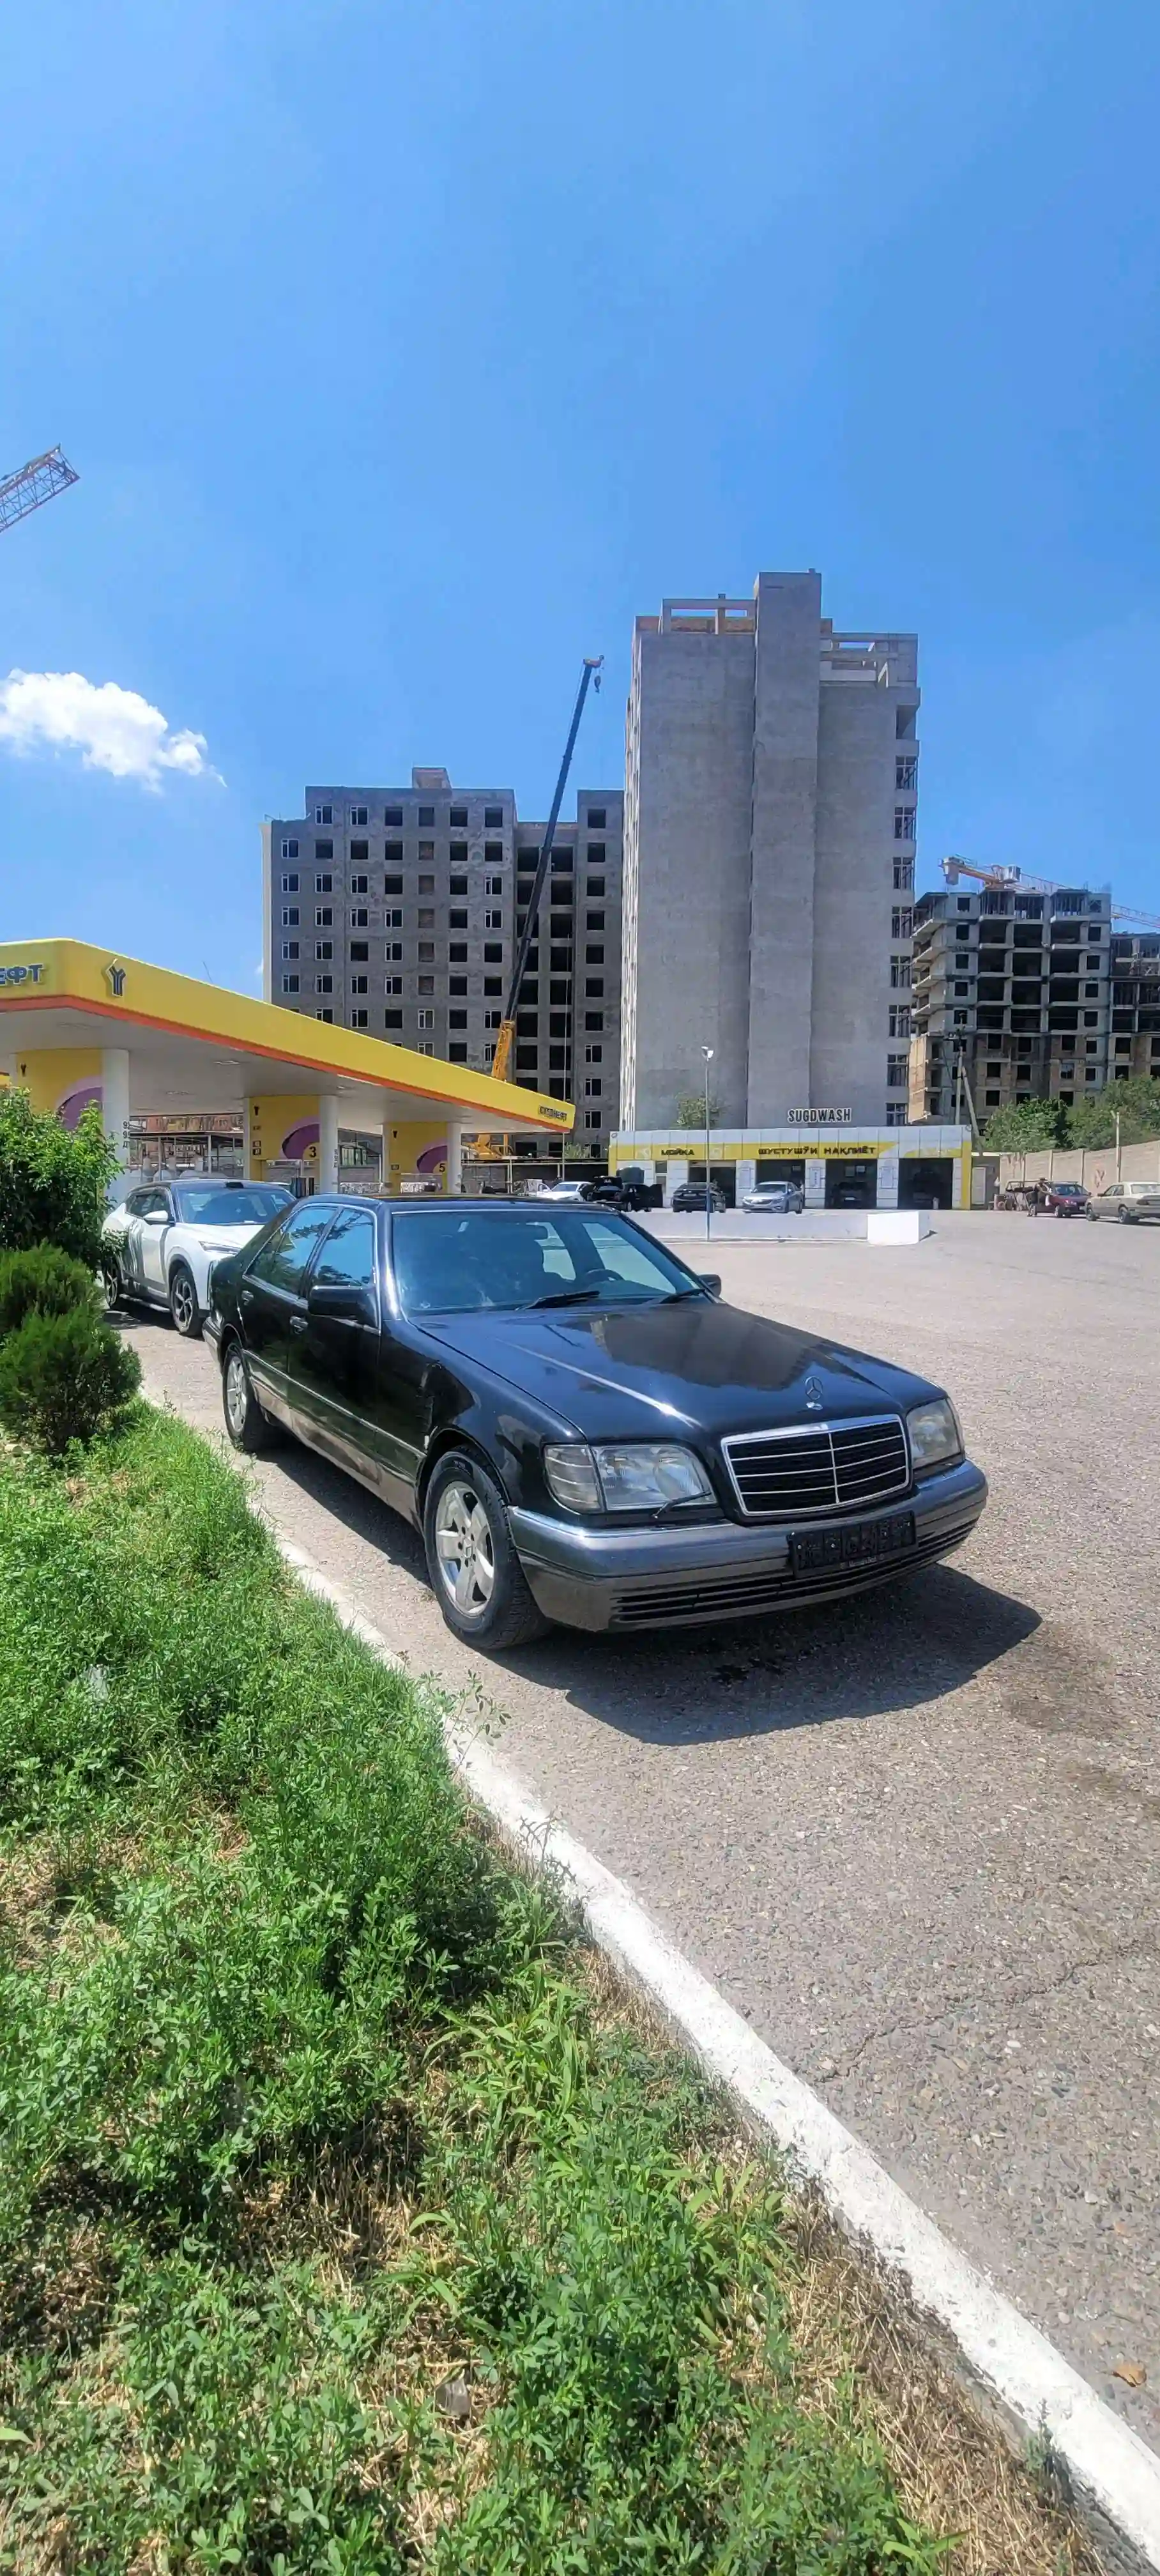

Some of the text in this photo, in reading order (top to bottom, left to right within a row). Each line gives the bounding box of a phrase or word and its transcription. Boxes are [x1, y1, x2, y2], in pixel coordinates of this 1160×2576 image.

[787, 1108, 852, 1123] SUGDWASH
[123, 1131, 130, 1139] 9
[309, 1146, 317, 1158] 3
[661, 1147, 694, 1156] МОЙКА
[439, 1163, 446, 1173] 5
